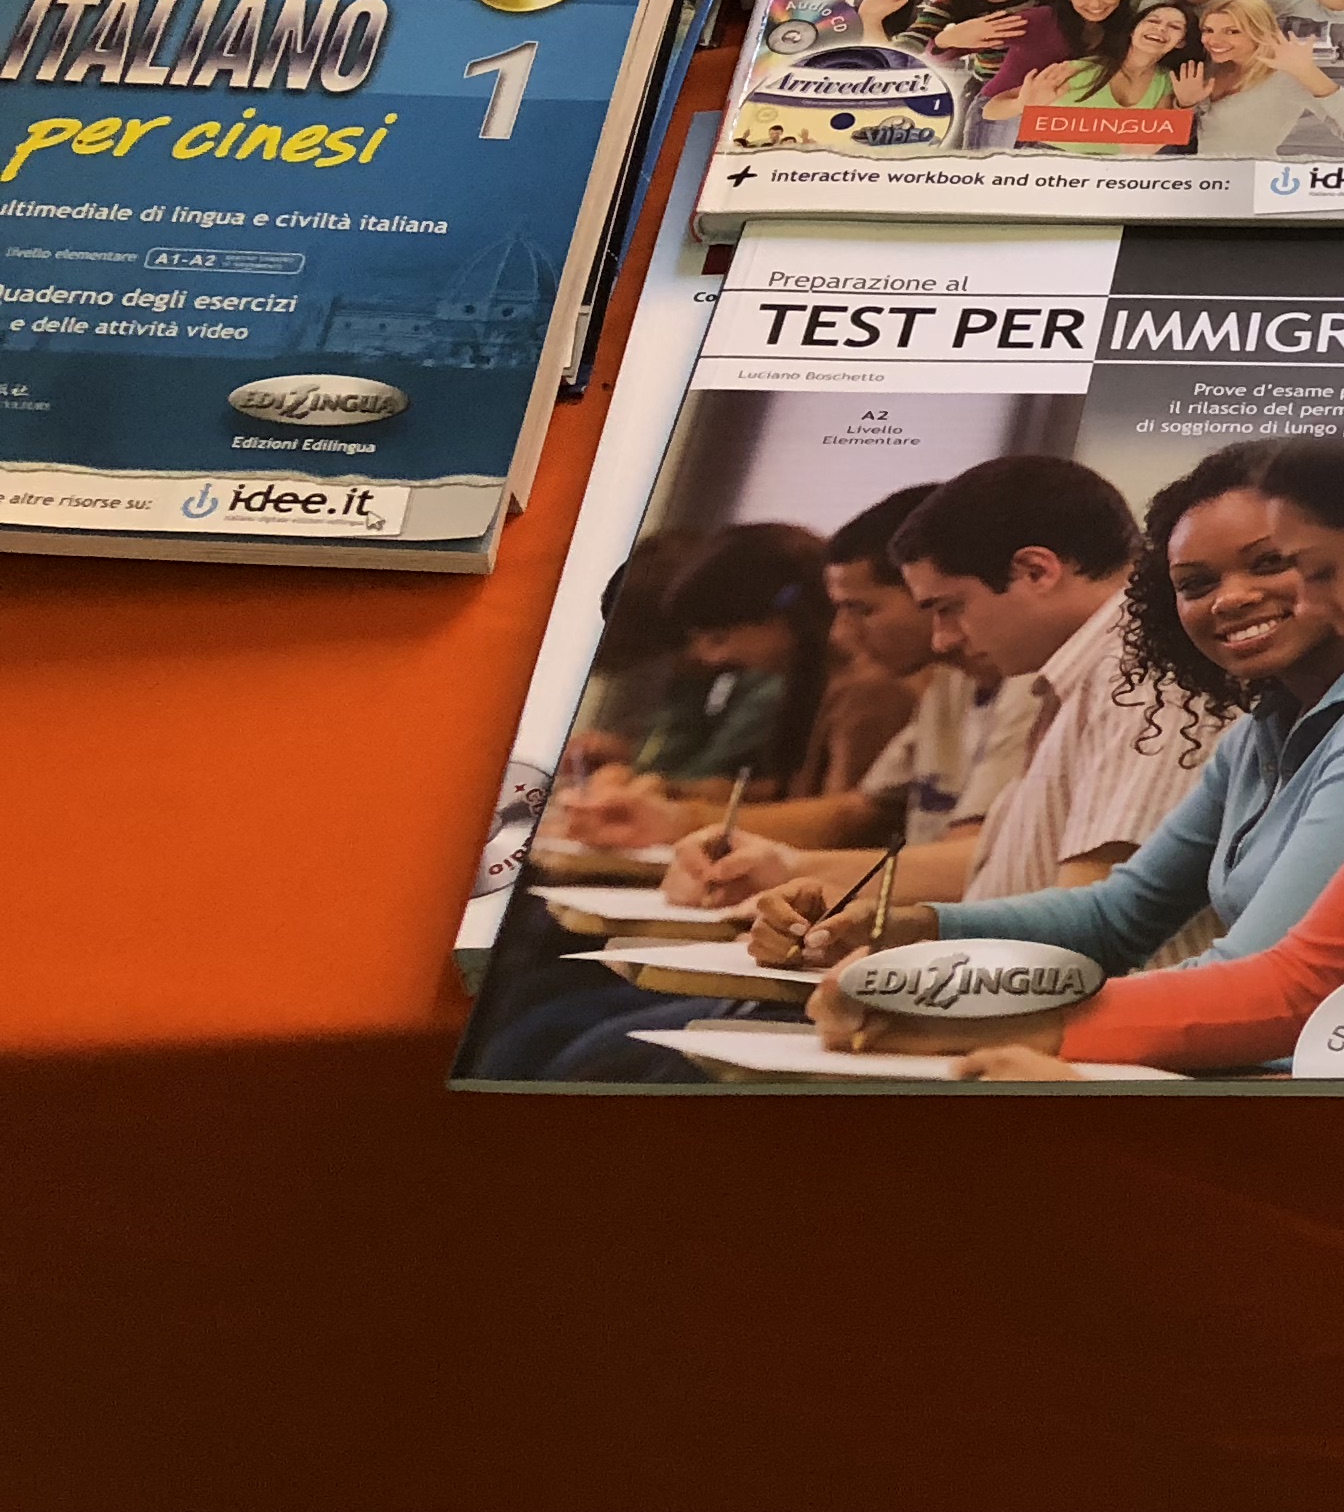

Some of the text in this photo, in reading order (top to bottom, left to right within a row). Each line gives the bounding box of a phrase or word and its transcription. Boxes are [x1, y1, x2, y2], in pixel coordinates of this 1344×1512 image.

[463, 40, 539, 140] 1
[1035, 115, 1174, 136] EDILINGUA
[0, 108, 399, 182] per cinesi
[770, 168, 1193, 192] interactive workbook other resources
[171, 205, 449, 236] lingua civiltà italiana
[154, 252, 217, 269] A1-A2
[769, 272, 937, 295] Preparazione
[120, 289, 298, 313] degli esercizi
[94, 318, 179, 340] attività
[758, 302, 935, 350] TEST
[951, 306, 1087, 352] PER
[738, 370, 885, 384] Luciano Boschetto
[1194, 382, 1333, 399] Prove d'esame
[861, 409, 889, 422] A2
[1187, 401, 1254, 418] rilascio
[1160, 418, 1256, 439] soggiorno
[1285, 420, 1336, 440] lungo
[57, 495, 122, 510] risorse
[228, 484, 375, 516] idee.it
[856, 954, 1086, 1006] EDILINGUA
